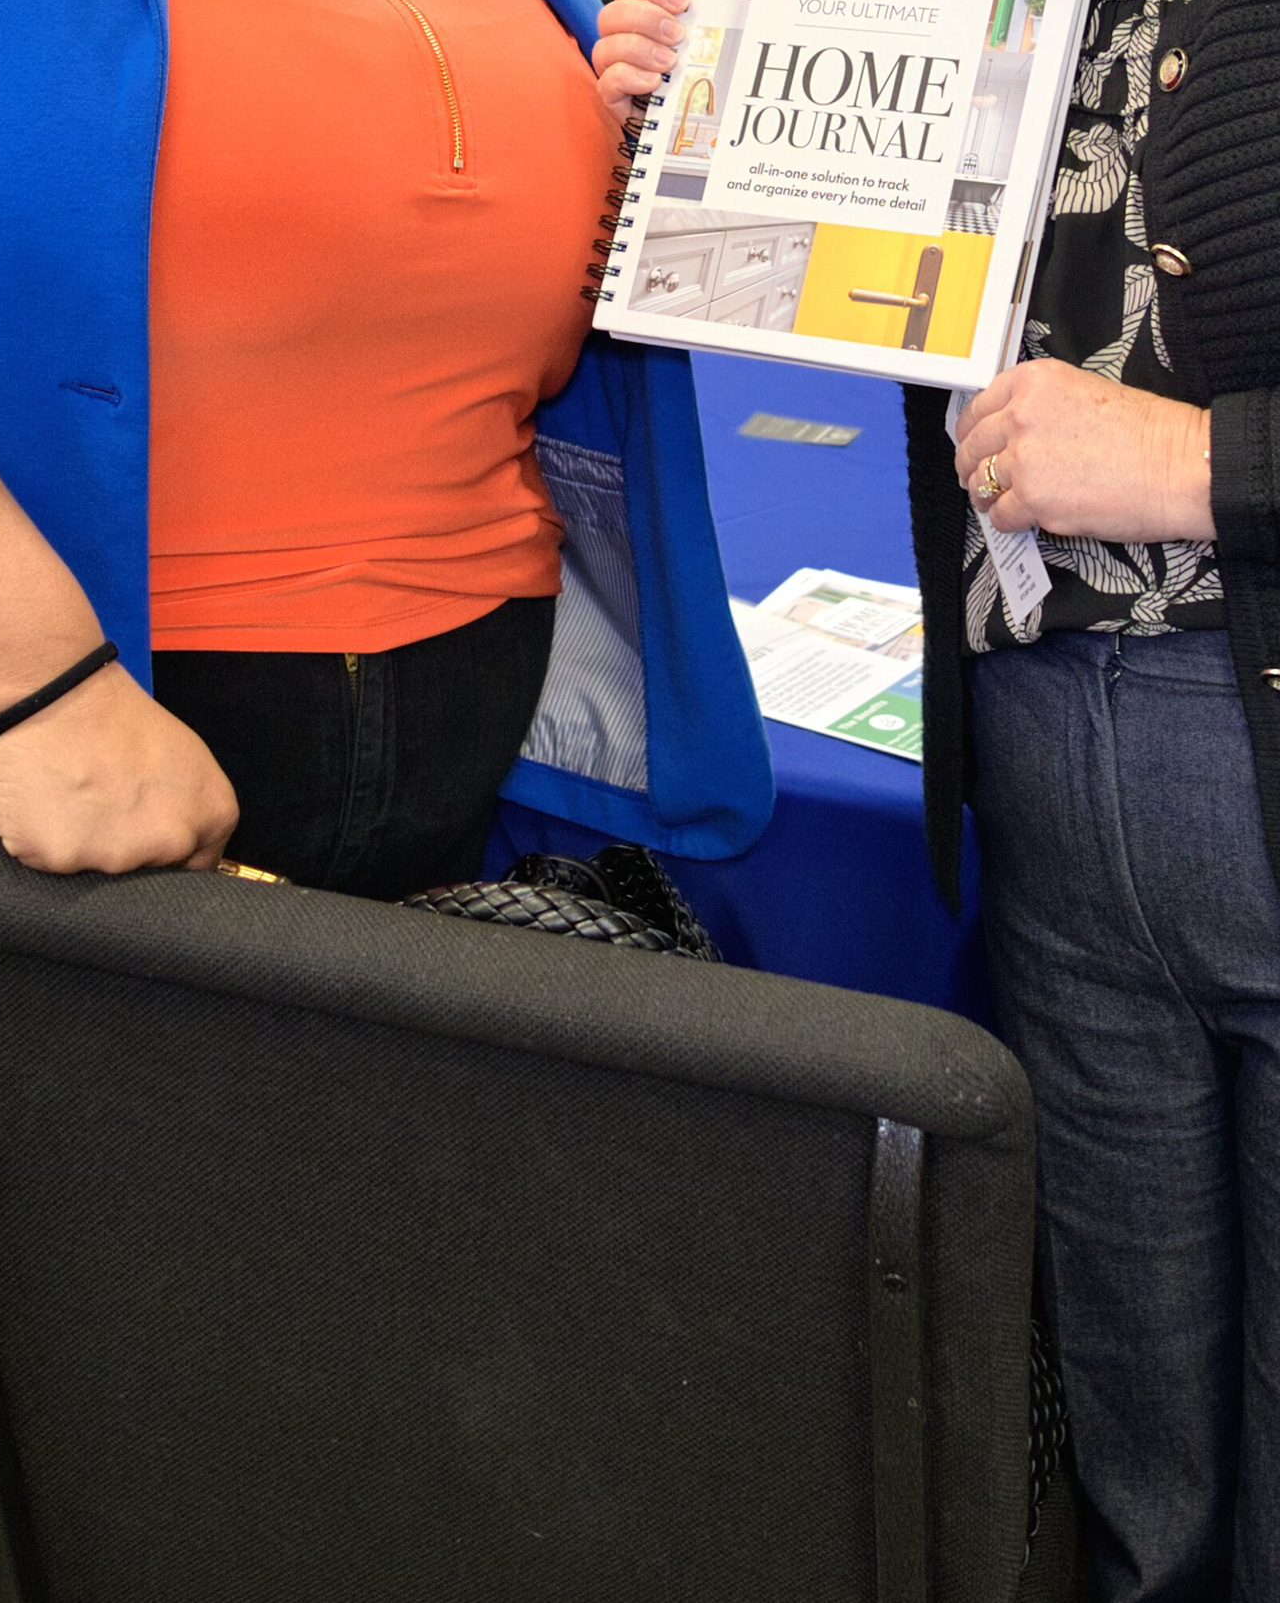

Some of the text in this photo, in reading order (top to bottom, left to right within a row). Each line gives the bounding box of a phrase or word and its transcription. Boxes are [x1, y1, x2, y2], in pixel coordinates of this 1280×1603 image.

[851, 2, 940, 24] ULTIMATE
[744, 41, 960, 118] HOME
[729, 103, 944, 163] JOURNAL
[749, 162, 910, 192] all-in-one solution to track
[726, 179, 926, 212] and organize every home detail
